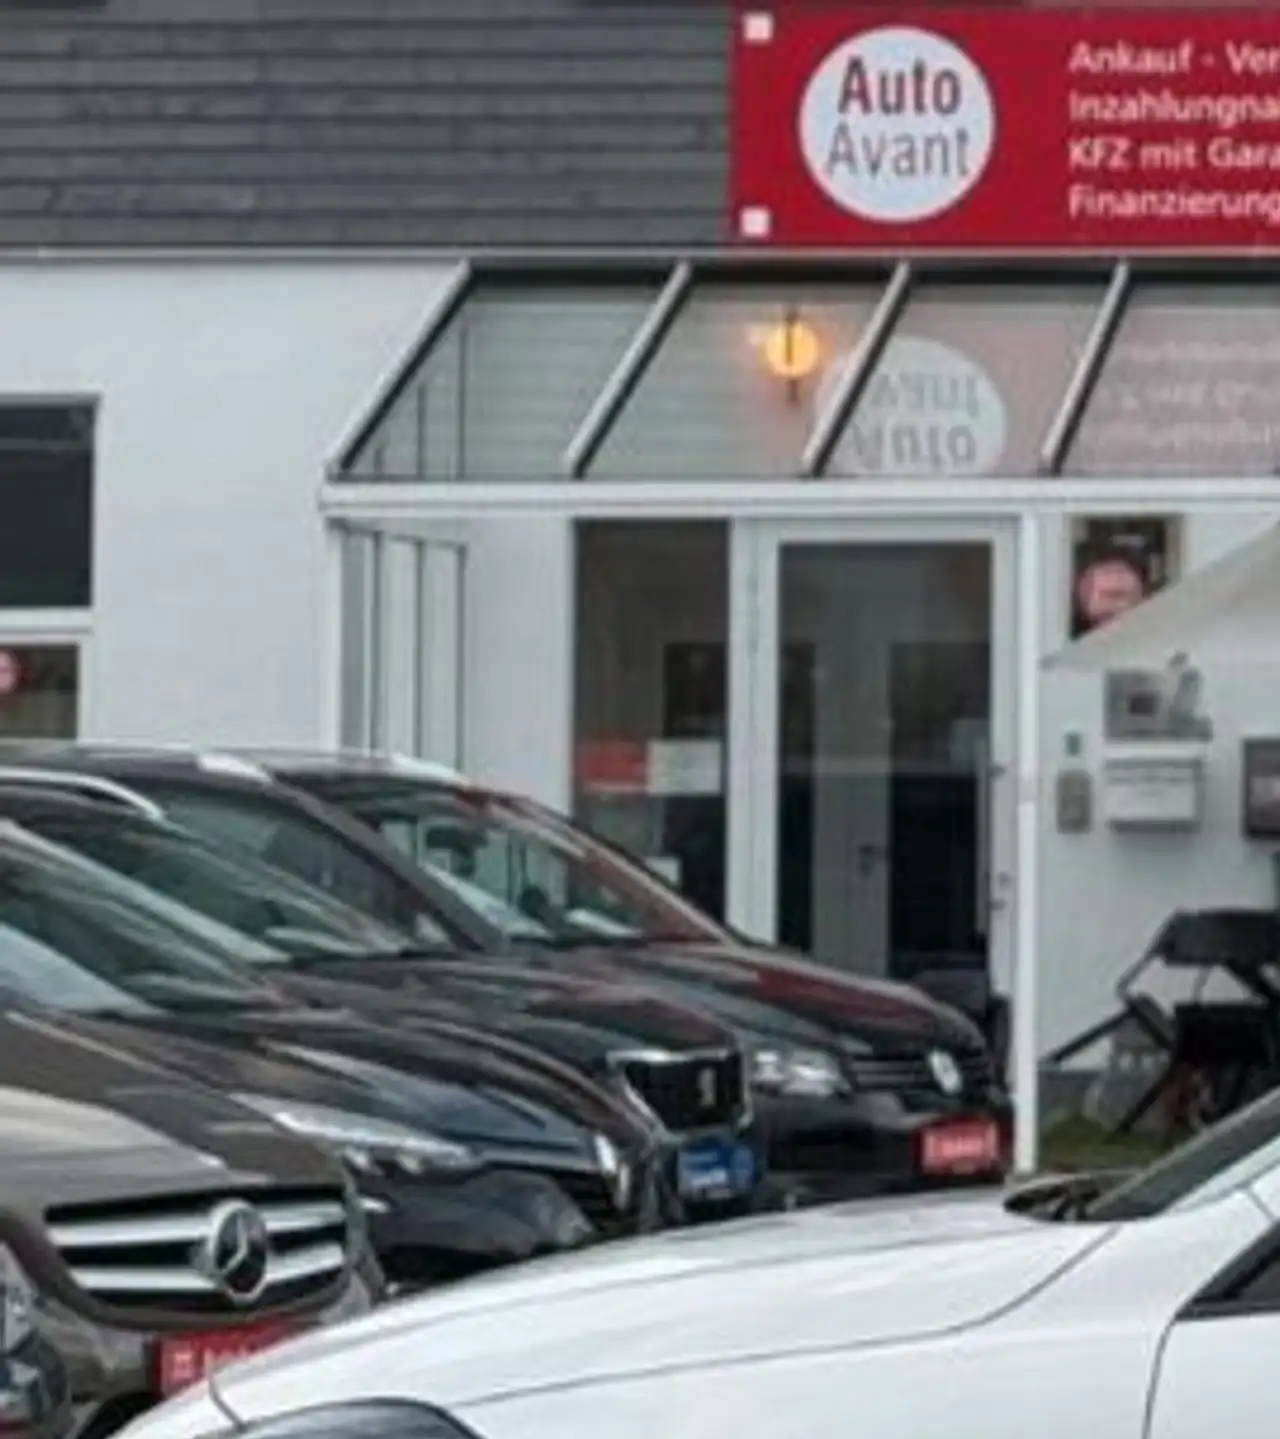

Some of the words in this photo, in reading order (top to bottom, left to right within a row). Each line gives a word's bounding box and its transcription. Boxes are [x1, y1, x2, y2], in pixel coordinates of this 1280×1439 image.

[1068, 38, 1193, 75] Ankauf
[837, 54, 963, 118] Auto
[824, 121, 971, 179] Avant
[1068, 136, 1131, 172] KFZ
[1140, 137, 1196, 172] mit
